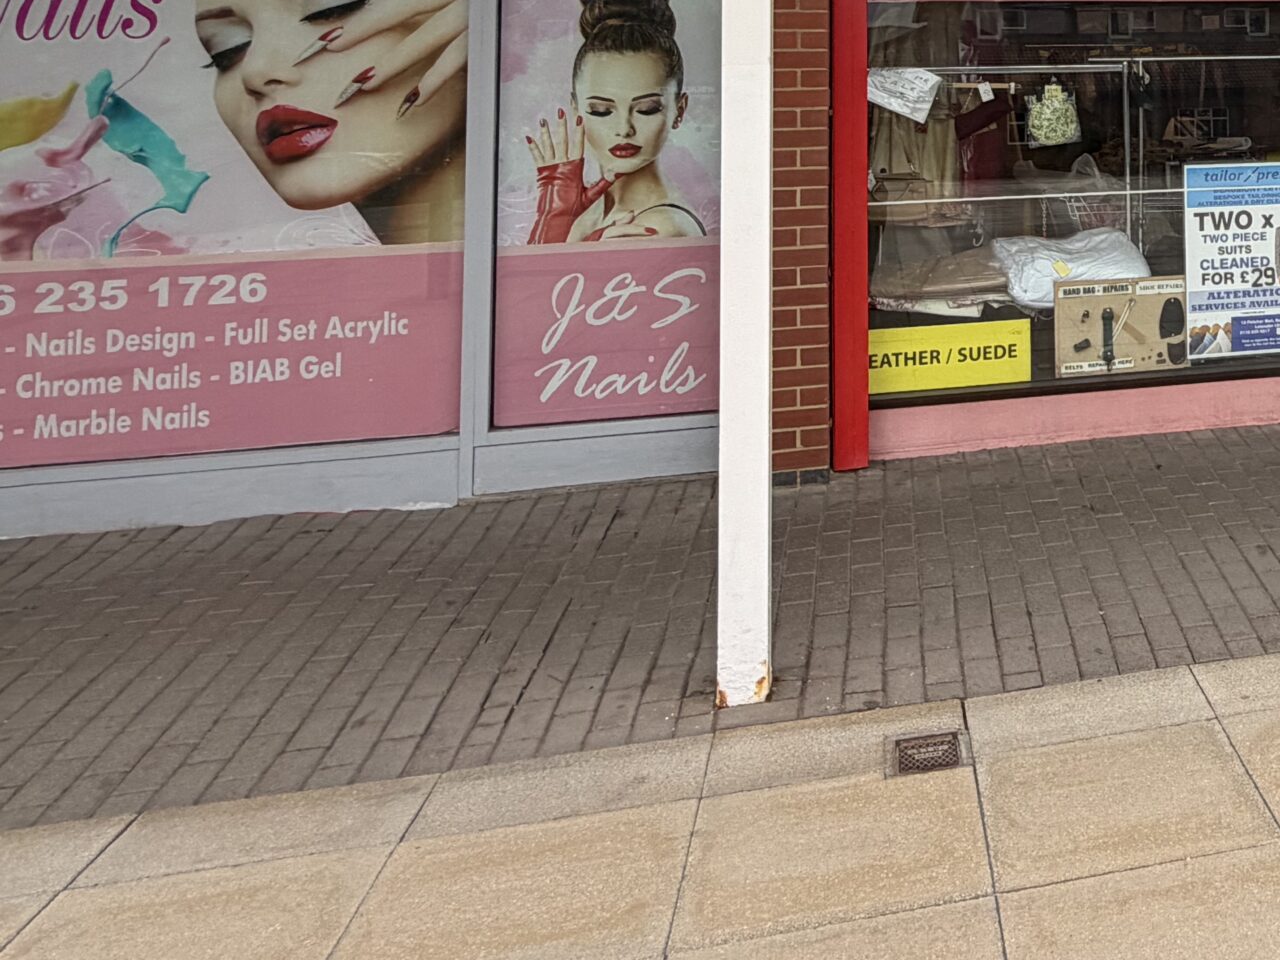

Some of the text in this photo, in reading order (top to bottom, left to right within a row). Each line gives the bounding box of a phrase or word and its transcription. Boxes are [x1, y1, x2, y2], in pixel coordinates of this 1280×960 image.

[1193, 210, 1253, 231] TWO
[1201, 231, 1268, 244] TWO PIECE
[1217, 245, 1252, 255] SUITS
[1200, 256, 1271, 270] CLEANED
[1201, 272, 1235, 286] FOR
[34, 278, 129, 314] 235
[148, 272, 267, 308] 1726
[1063, 287, 1081, 296] HAND
[1082, 286, 1096, 294] BAG
[1102, 284, 1129, 293] REPAIRS
[541, 268, 707, 355] J&S
[1191, 301, 1247, 312] SERVICES
[25, 328, 96, 358] Nails
[106, 322, 196, 357] Design
[224, 317, 268, 346] Full
[278, 315, 317, 342] Set
[325, 310, 409, 344] Acrylic
[958, 343, 1018, 363] SUEDE
[16, 369, 122, 400] Chrome
[132, 362, 201, 392] Nails
[229, 357, 291, 386] BIAB
[300, 353, 342, 380] Gel
[534, 341, 707, 403] Nails
[33, 407, 131, 440] Marble
[142, 402, 210, 432] Nails
